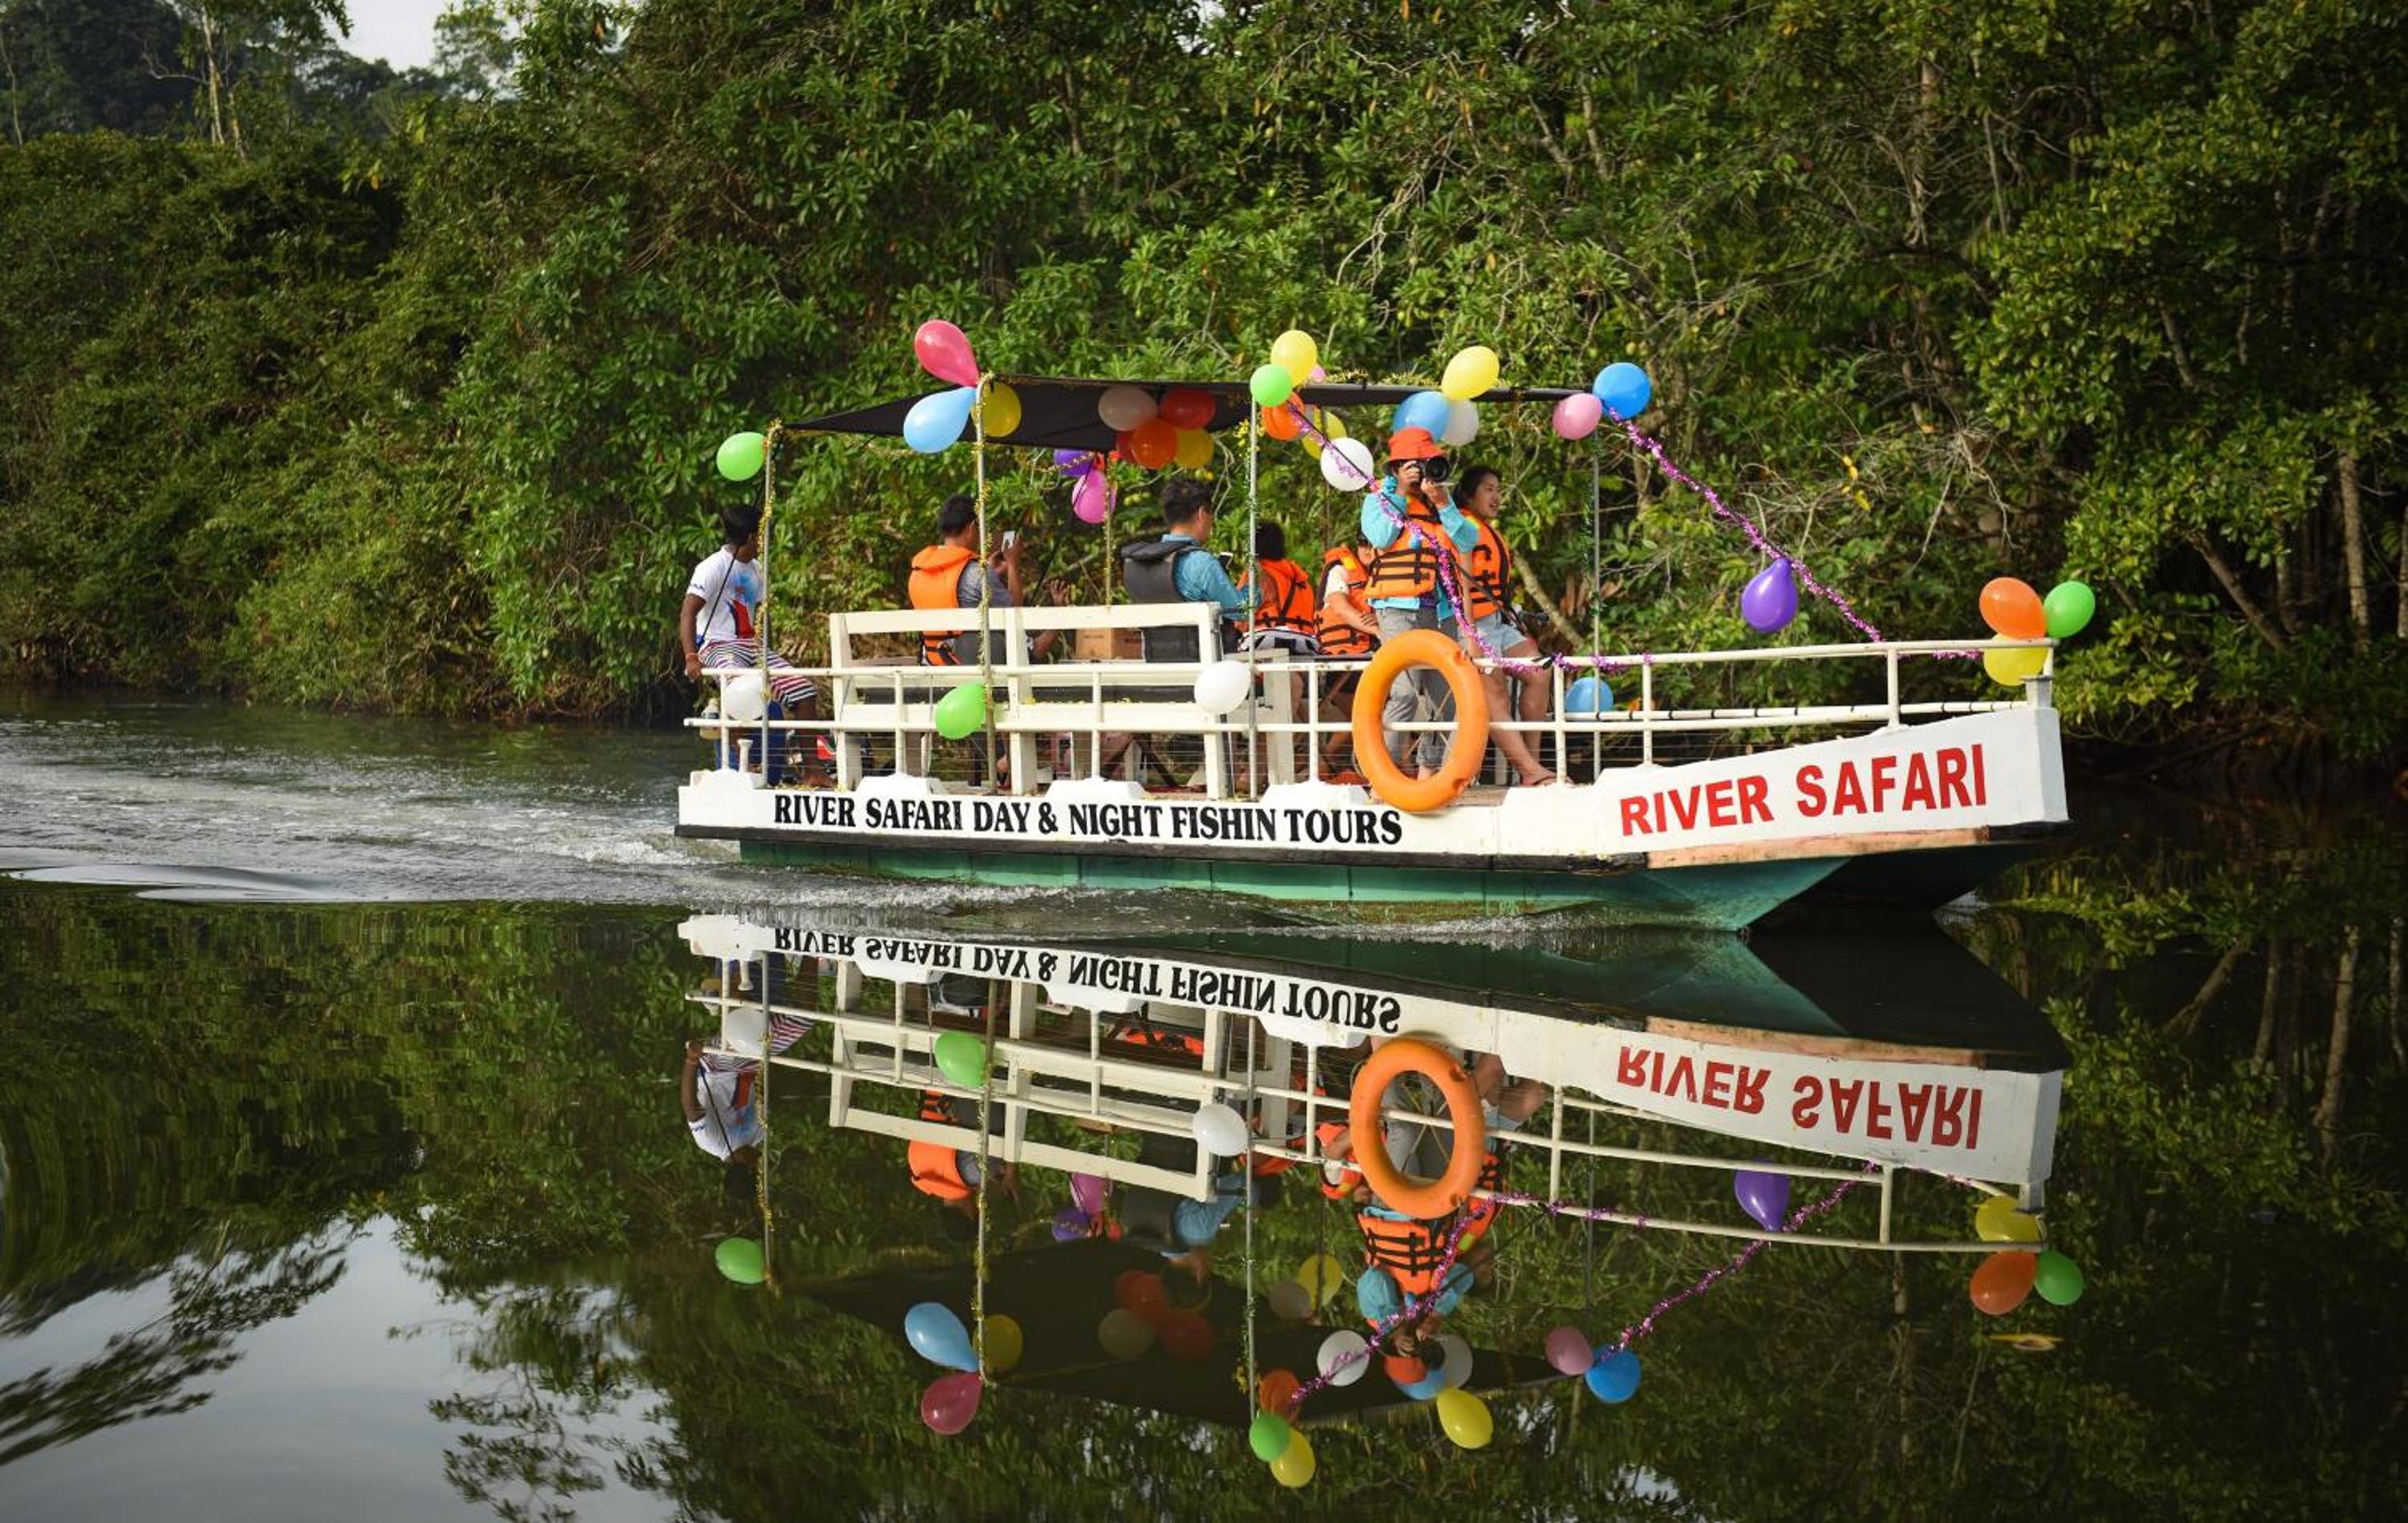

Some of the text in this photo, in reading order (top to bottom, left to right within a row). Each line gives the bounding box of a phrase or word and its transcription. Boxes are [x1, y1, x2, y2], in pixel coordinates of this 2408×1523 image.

[774, 794, 1402, 844] RIVER SAFARI DAY & NIGHT FISHIN TOURS
[1620, 744, 1987, 836] RIVER SAFARI
